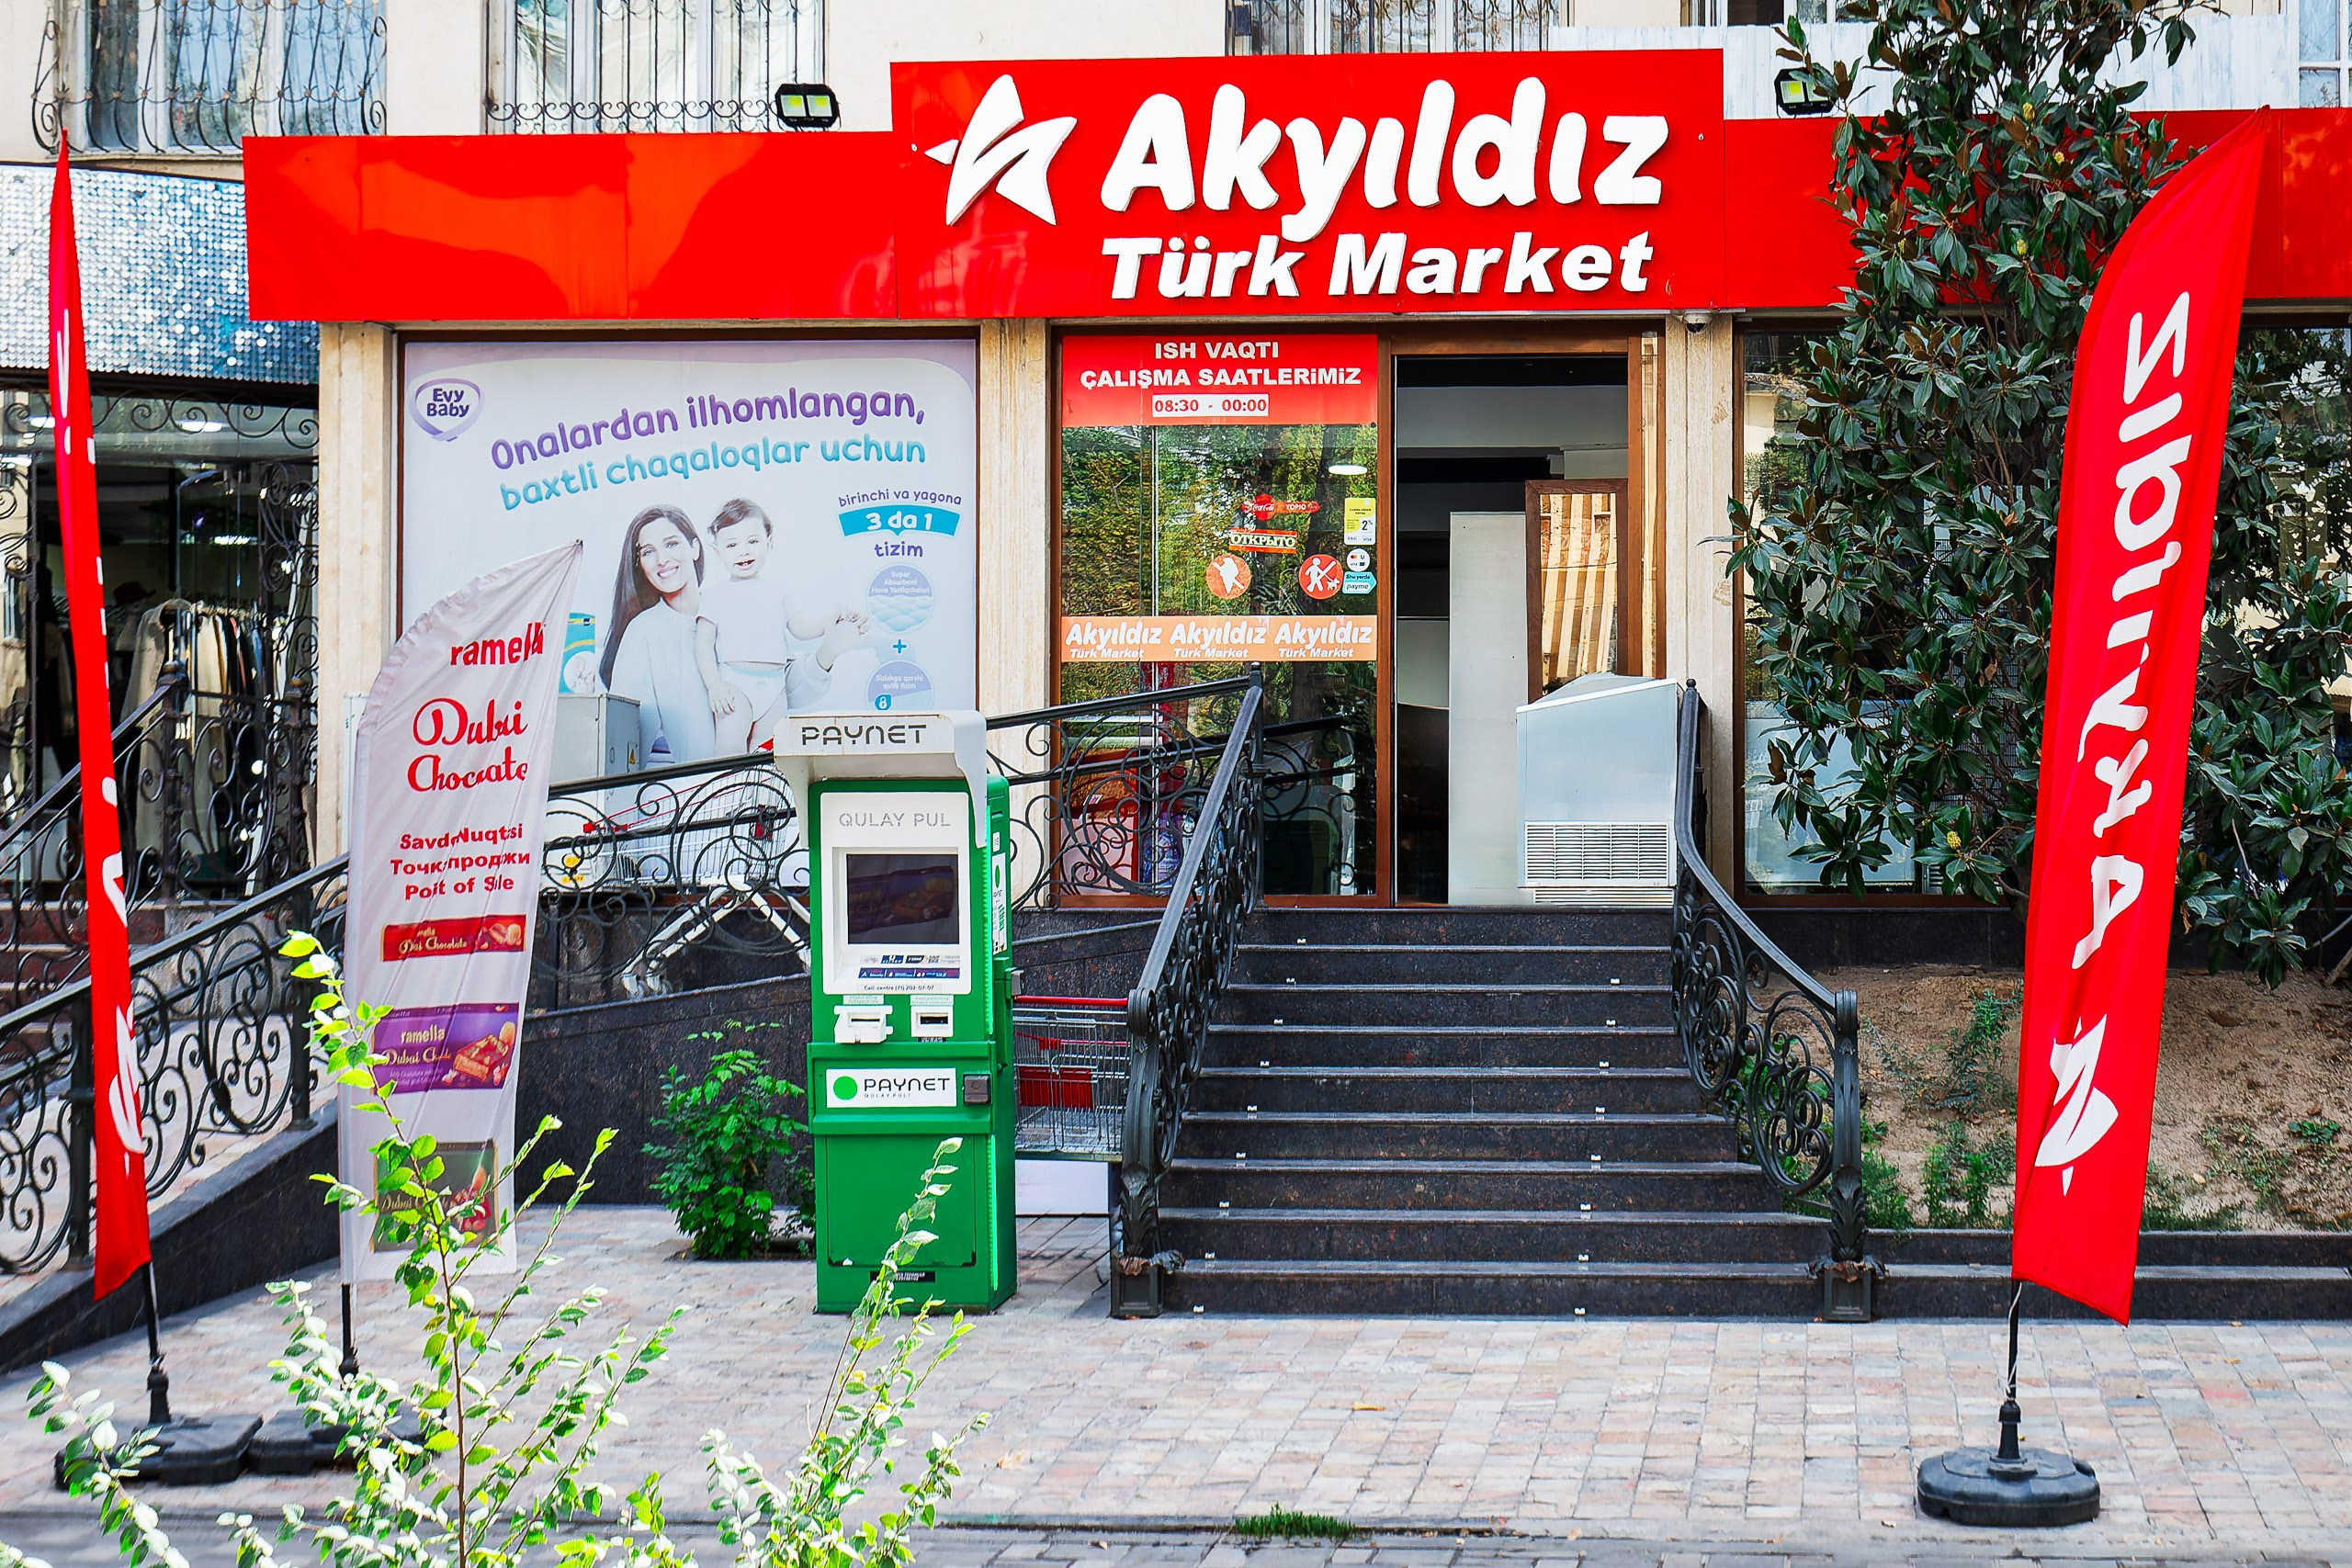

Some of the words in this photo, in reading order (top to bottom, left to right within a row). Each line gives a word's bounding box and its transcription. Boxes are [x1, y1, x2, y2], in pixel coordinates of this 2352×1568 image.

[1101, 75, 1669, 243] Akyıldız
[1102, 234, 1306, 299] Türk
[1329, 230, 1655, 297] Market
[1154, 343, 1197, 359] ISH
[1204, 341, 1280, 360] VAQTI
[1080, 369, 1192, 390] ÇALIŞMA
[432, 388, 465, 403] Evy
[426, 402, 471, 418] Baby
[1154, 400, 1199, 412] 08:30
[1221, 399, 1267, 412] 00:00
[491, 407, 678, 470] Onalardan
[686, 387, 925, 428] ilhomlangan,
[500, 461, 599, 512] baxtli
[605, 435, 810, 485] chaqaloqlar
[820, 433, 926, 463] uchun
[838, 489, 889, 507] birinchi
[893, 490, 910, 500] va
[913, 491, 962, 505] yagona
[865, 512, 882, 531] 3
[888, 510, 918, 529] da
[924, 513, 933, 531] 1
[874, 540, 923, 558] tizim
[1231, 534, 1295, 547] ОТКРЫТО
[1066, 621, 1163, 651] Akyıldız
[1170, 621, 1267, 650] Akyıldız
[1274, 620, 1373, 650] Akyıldız
[1069, 648, 1097, 659] Türk
[1101, 648, 1145, 659] Market
[1174, 648, 1201, 659] Türk
[1204, 648, 1249, 659] Market
[1278, 648, 1306, 658] Türk
[1309, 648, 1354, 658] Market
[801, 725, 927, 745] PAYNET
[839, 812, 905, 827] QULAY
[913, 812, 951, 827] PUL
[447, 852, 530, 872] проджи
[453, 876, 476, 894] of
[401, 1024, 446, 1044] ramella
[864, 1077, 951, 1092] PAYNET
